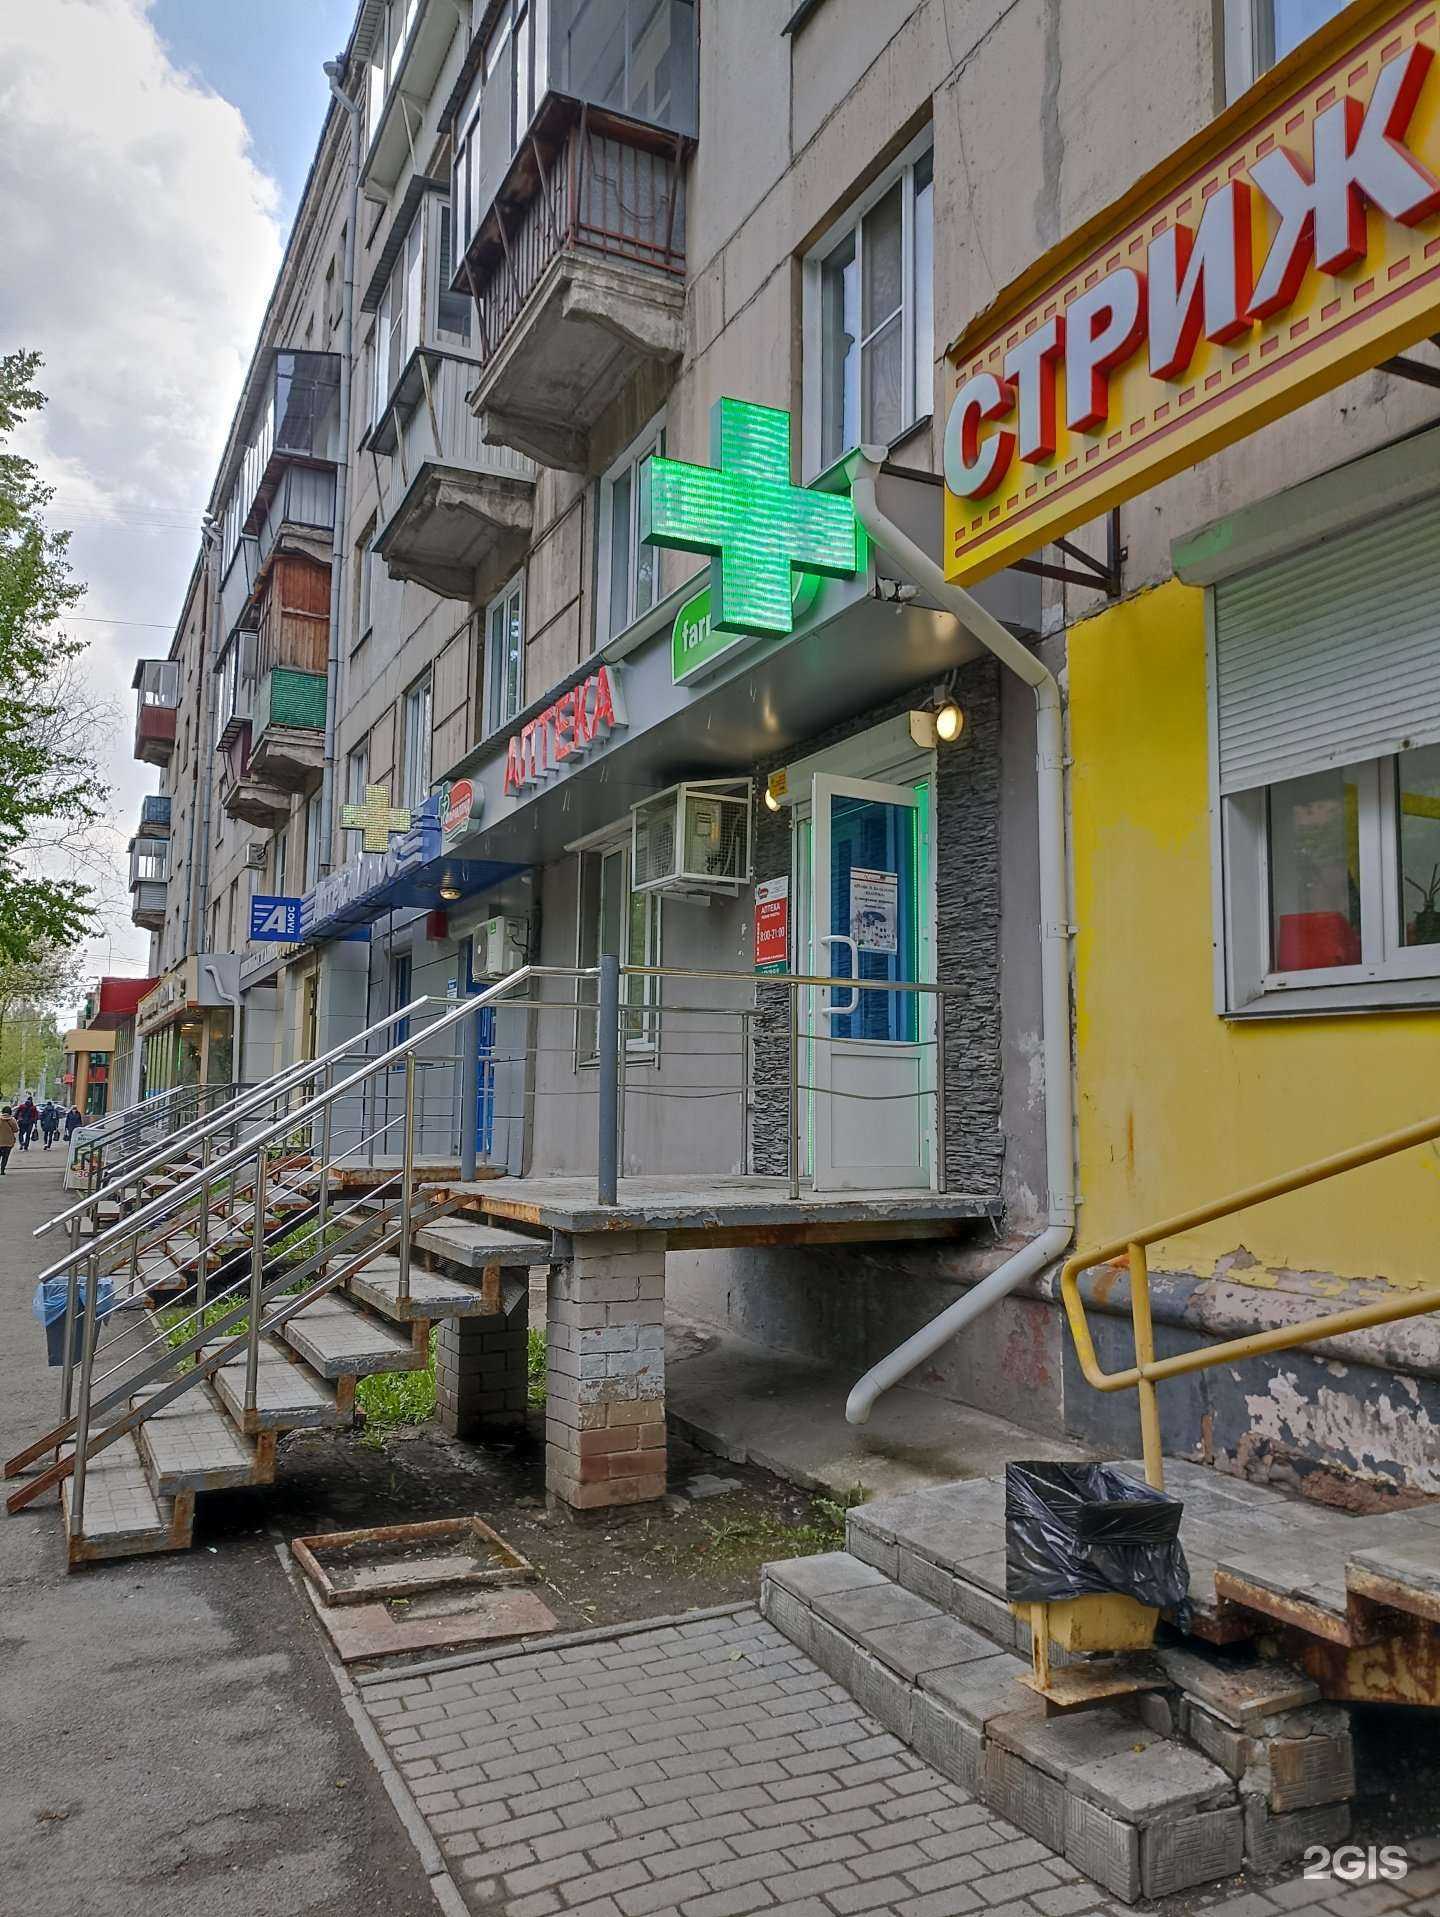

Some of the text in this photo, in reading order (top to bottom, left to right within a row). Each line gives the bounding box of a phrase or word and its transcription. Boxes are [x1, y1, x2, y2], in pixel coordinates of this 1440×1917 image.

[943, 42, 1440, 500] СТРИЖ
[504, 663, 628, 797] АПТЕКА
[761, 903, 780, 914] АПТЕКА
